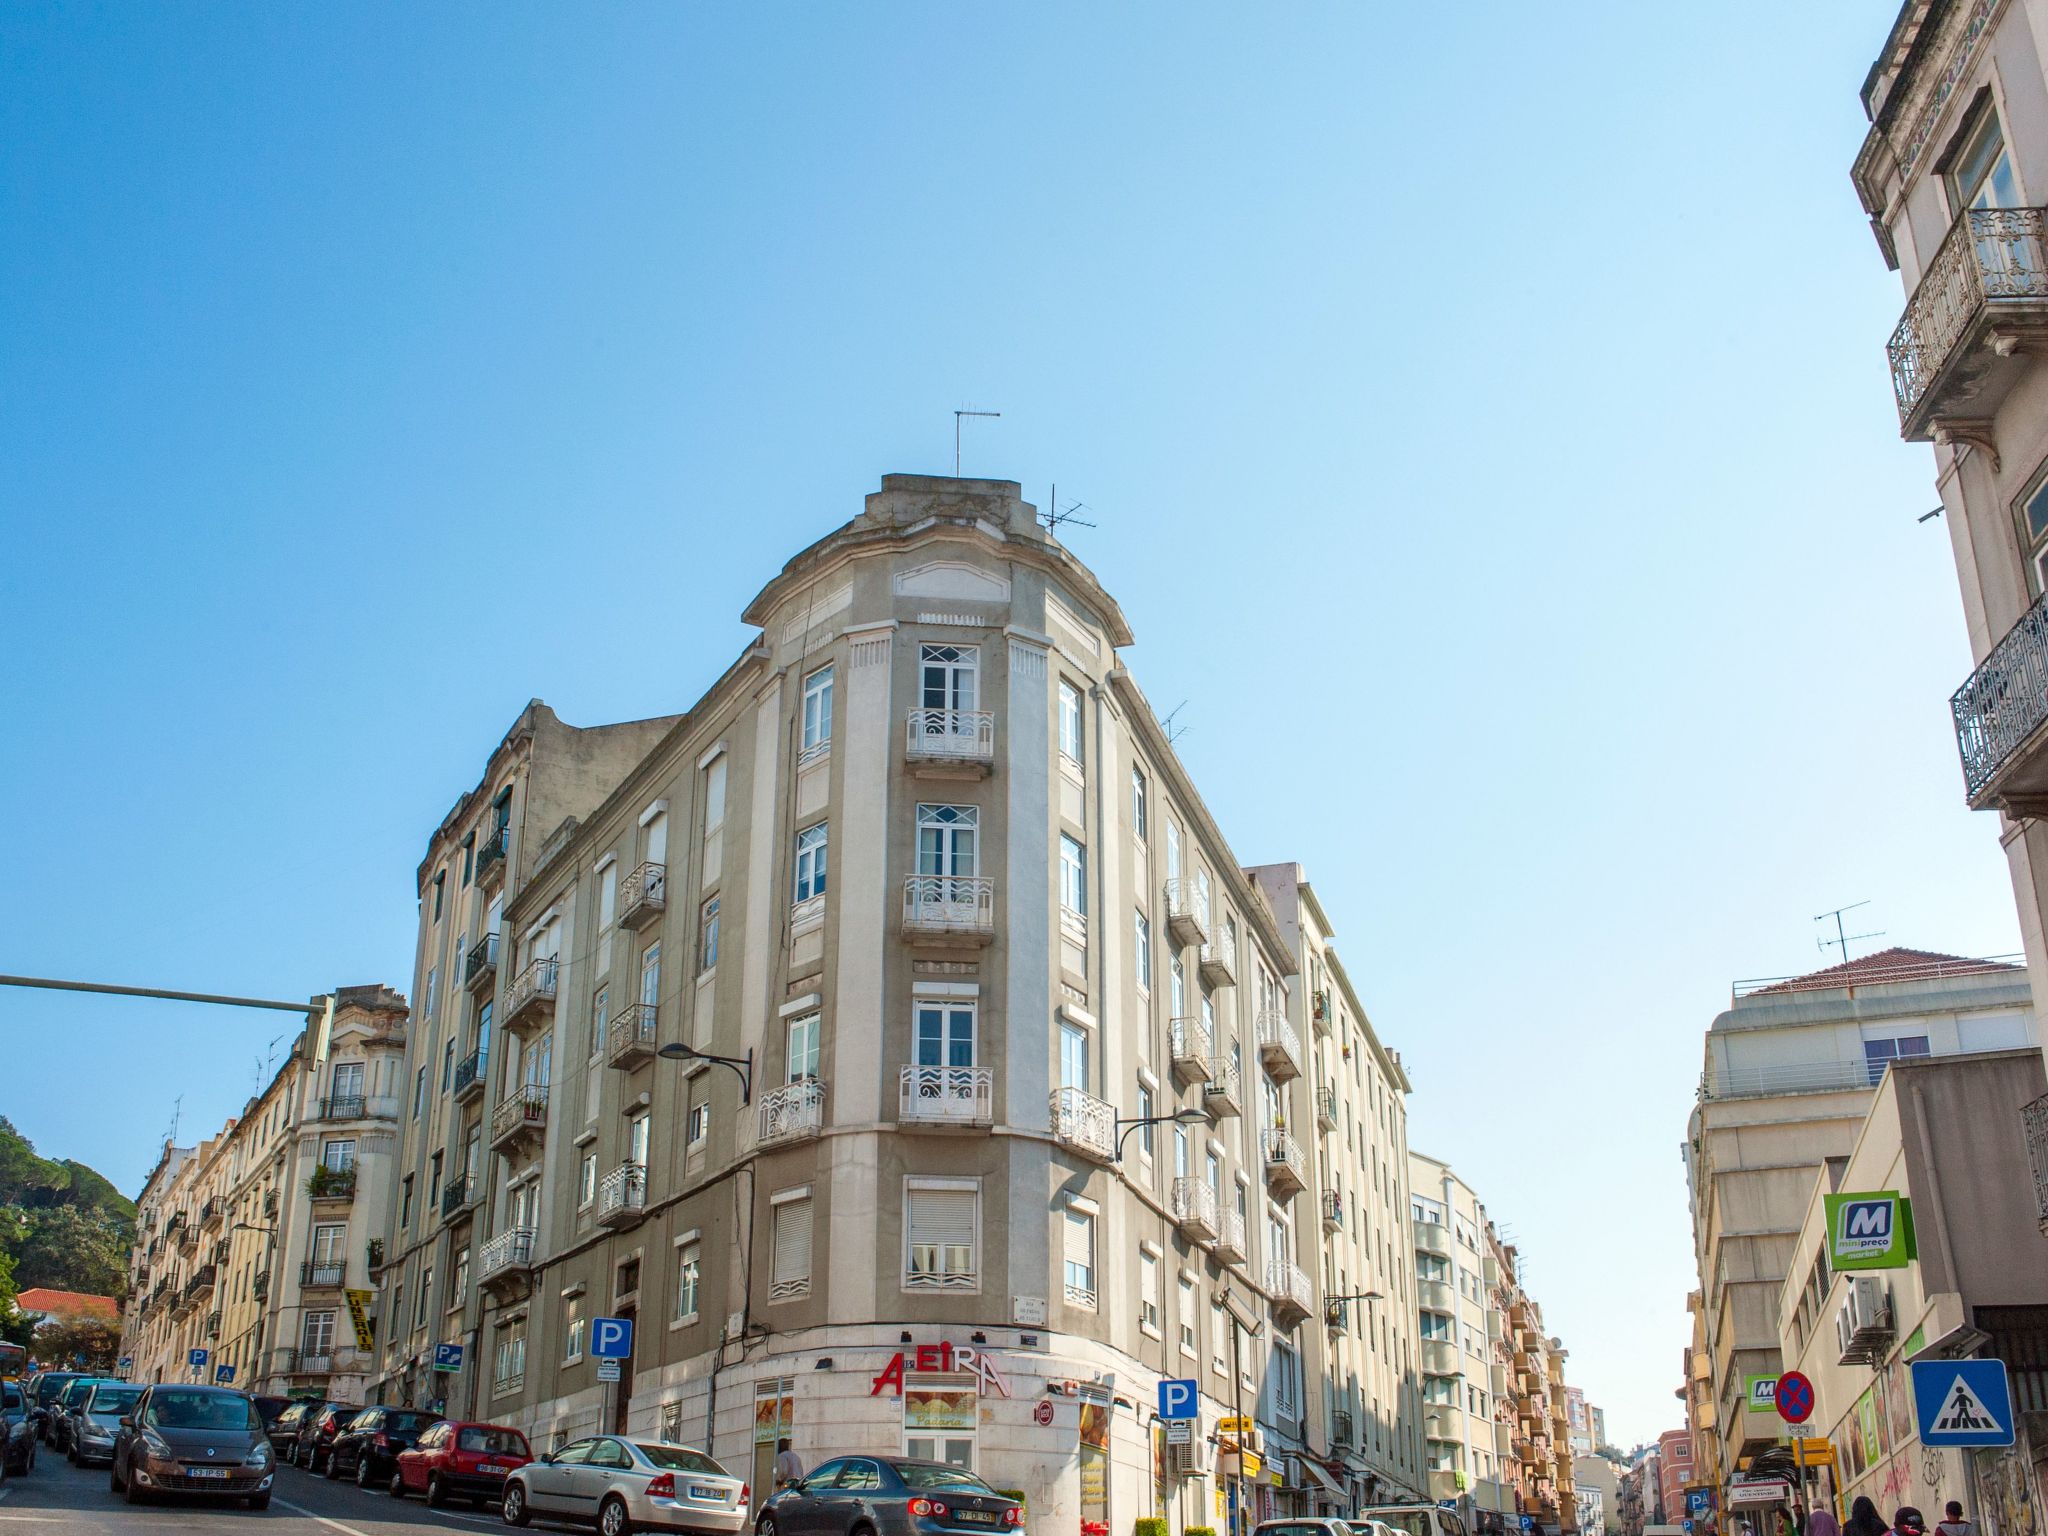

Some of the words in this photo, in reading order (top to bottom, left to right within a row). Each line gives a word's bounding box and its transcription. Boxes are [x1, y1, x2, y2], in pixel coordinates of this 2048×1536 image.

[1850, 1206, 1886, 1235] M
[1839, 1239, 1889, 1248] minipreço
[1848, 1250, 1879, 1259] market
[346, 1291, 373, 1351] FUNERAIS
[600, 1322, 622, 1353] P
[194, 1350, 204, 1363] P
[438, 1346, 450, 1359] P
[1757, 1383, 1774, 1395] M
[1167, 1384, 1188, 1415] P
[917, 1414, 964, 1425] Padaria
[1692, 1495, 1701, 1509] P
[1521, 1517, 1529, 1529] P
[1684, 1521, 1690, 1531] P
